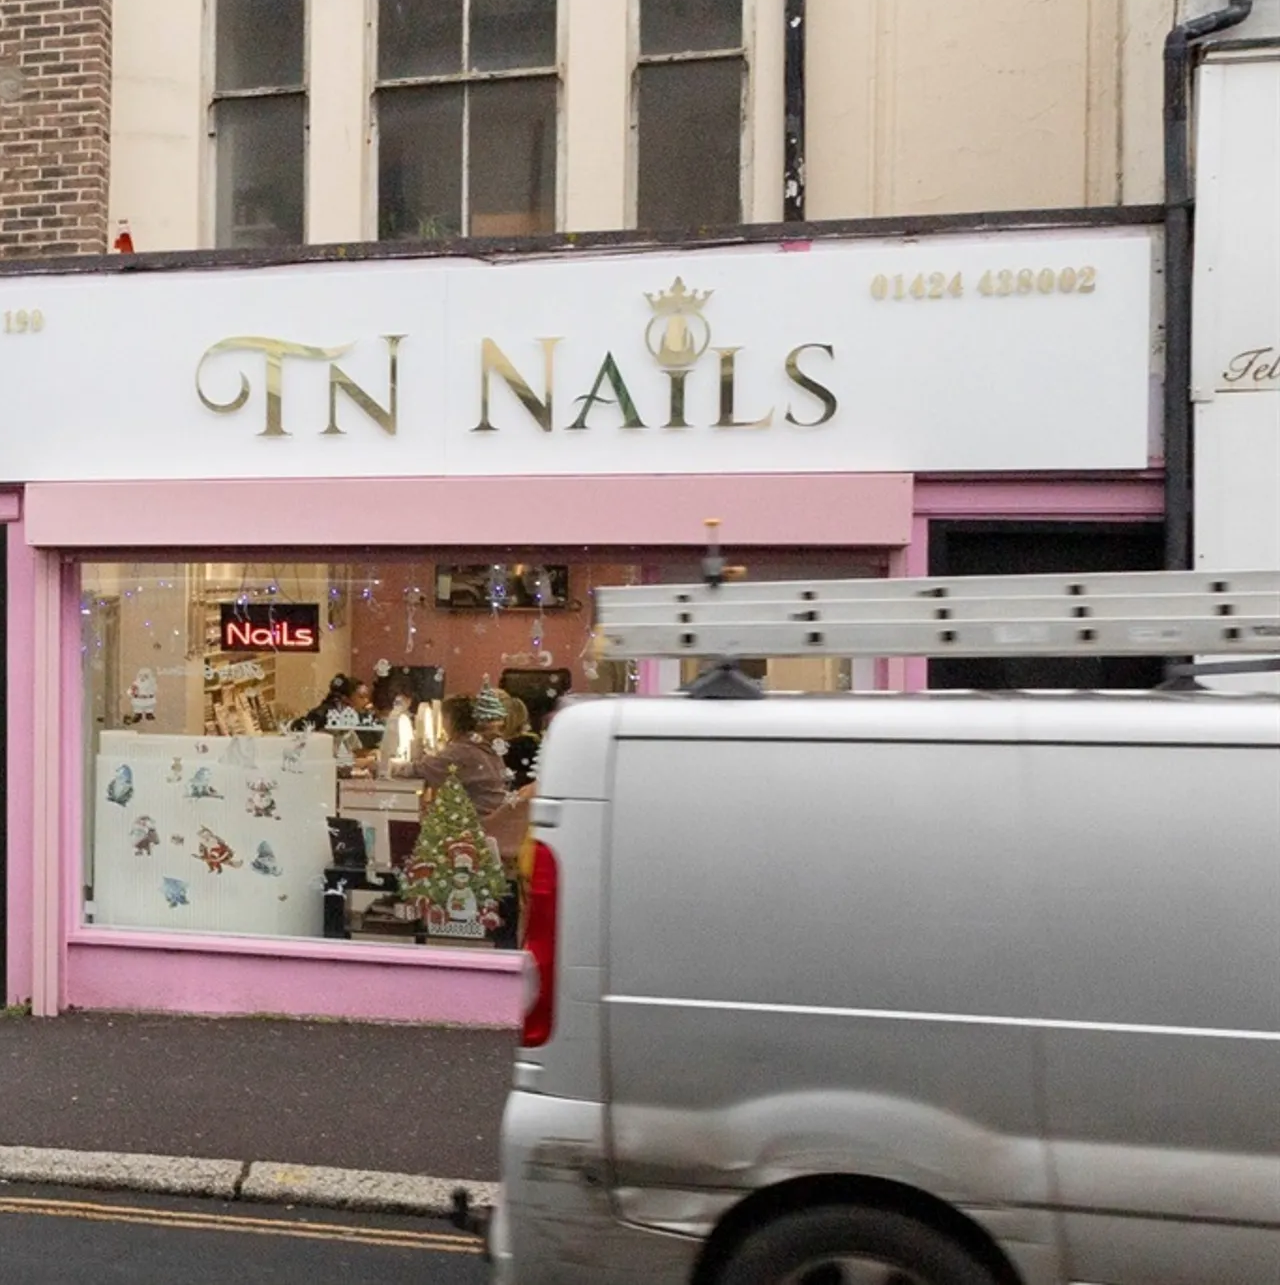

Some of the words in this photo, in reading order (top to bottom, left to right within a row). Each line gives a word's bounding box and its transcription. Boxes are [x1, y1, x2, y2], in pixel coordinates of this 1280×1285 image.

[870, 271, 964, 302] 01424
[976, 266, 1097, 298] 438002
[195, 334, 409, 436] TN
